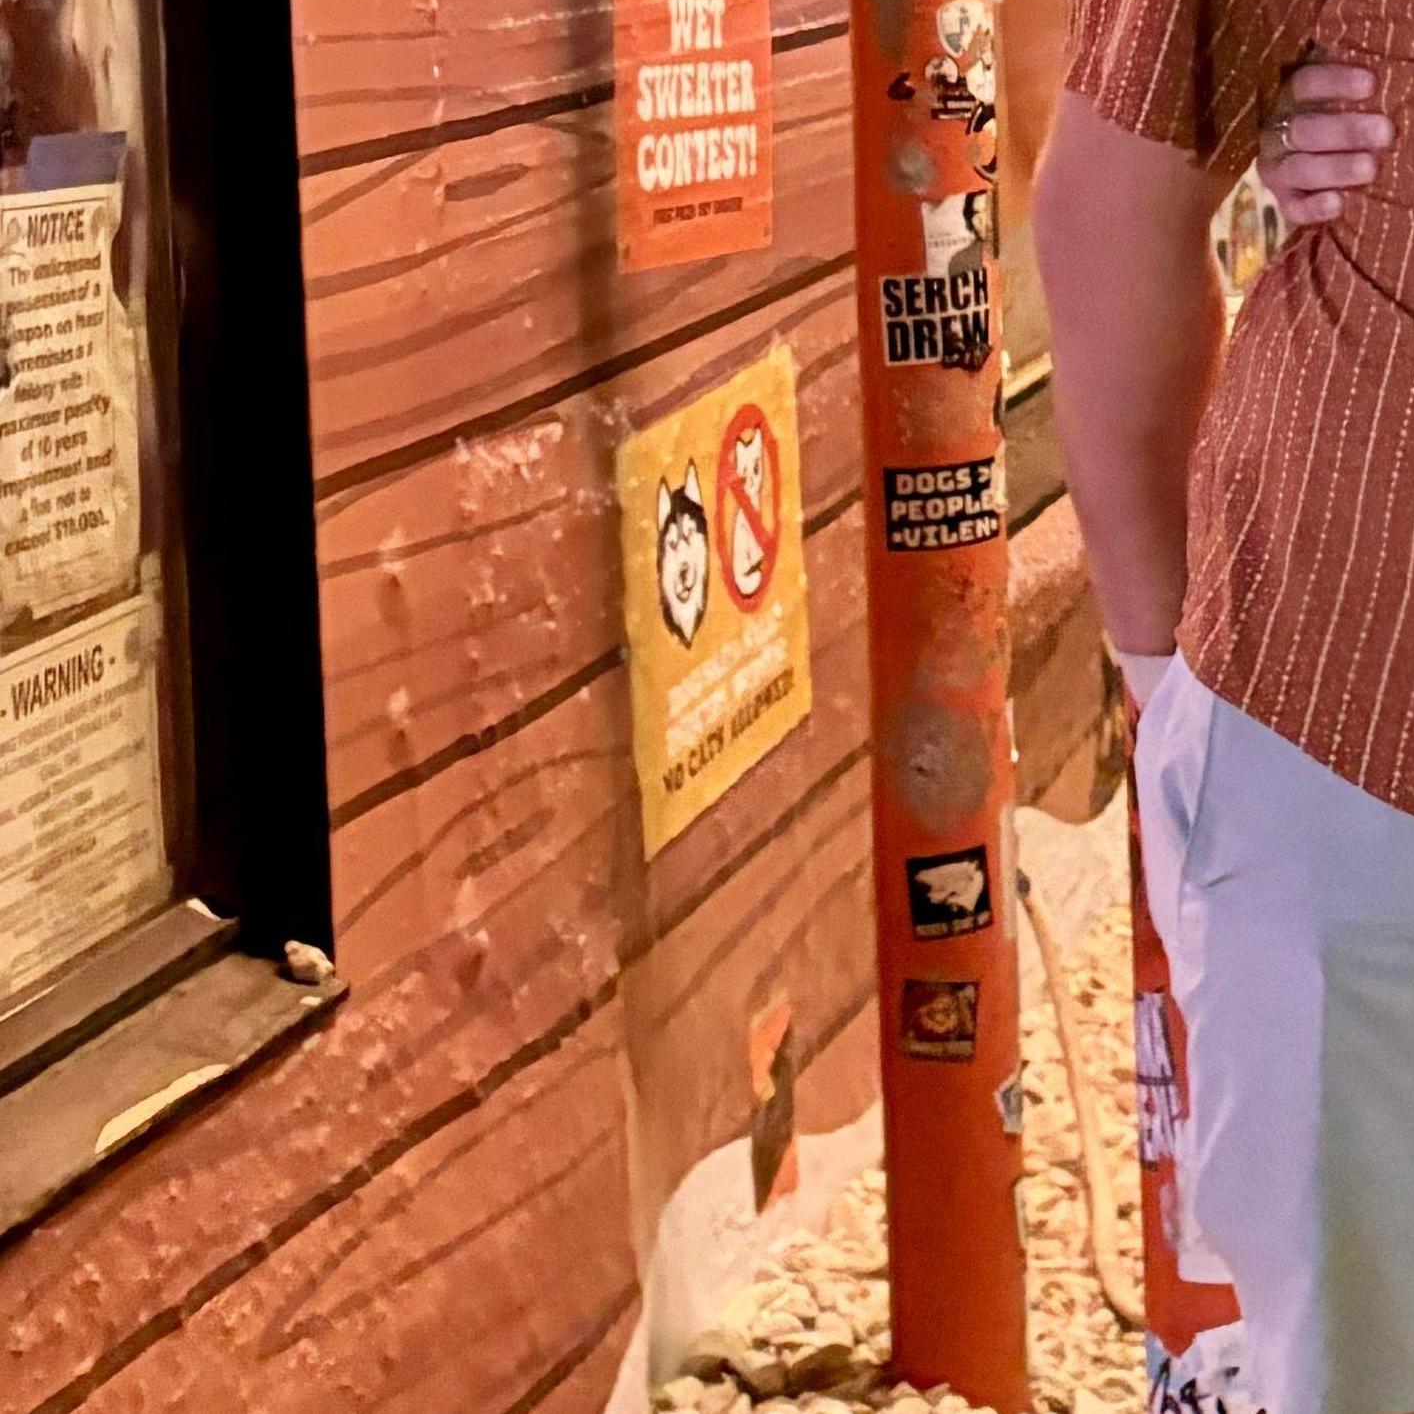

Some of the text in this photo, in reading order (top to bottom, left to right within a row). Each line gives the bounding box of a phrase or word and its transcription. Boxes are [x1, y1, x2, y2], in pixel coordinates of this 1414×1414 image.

[636, 59, 756, 123] SWEATER
[636, 124, 757, 192] CONTEST!
[27, 208, 86, 249] NOTICE
[882, 267, 989, 319] SERCH
[895, 467, 972, 495] DOGS
[10, 644, 105, 722] WARNING
